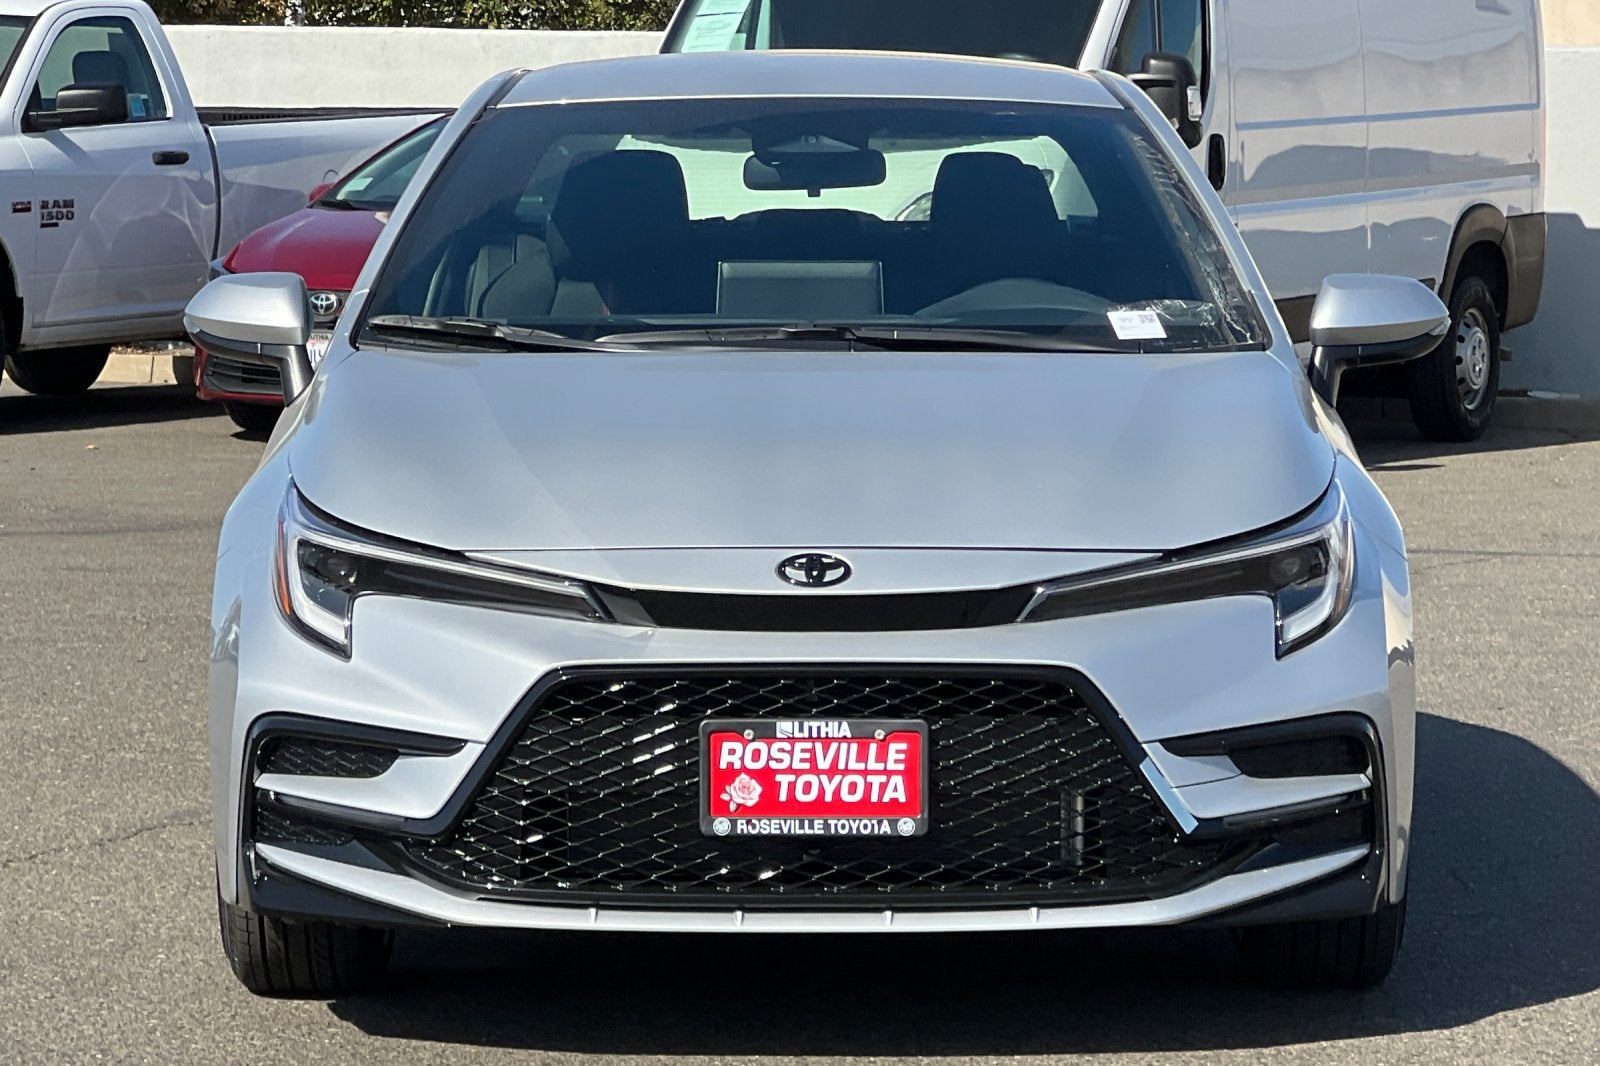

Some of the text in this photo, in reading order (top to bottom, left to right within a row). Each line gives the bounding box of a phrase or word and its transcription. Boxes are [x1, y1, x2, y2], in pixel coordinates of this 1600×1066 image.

[41, 199, 75, 209] RAM
[41, 210, 75, 221] 1500
[793, 721, 852, 738] LITHIA
[719, 741, 908, 771] ROSEVILLE
[774, 773, 907, 803] TOYOTA
[736, 819, 892, 835] ROSEVILLE TOYOTA
